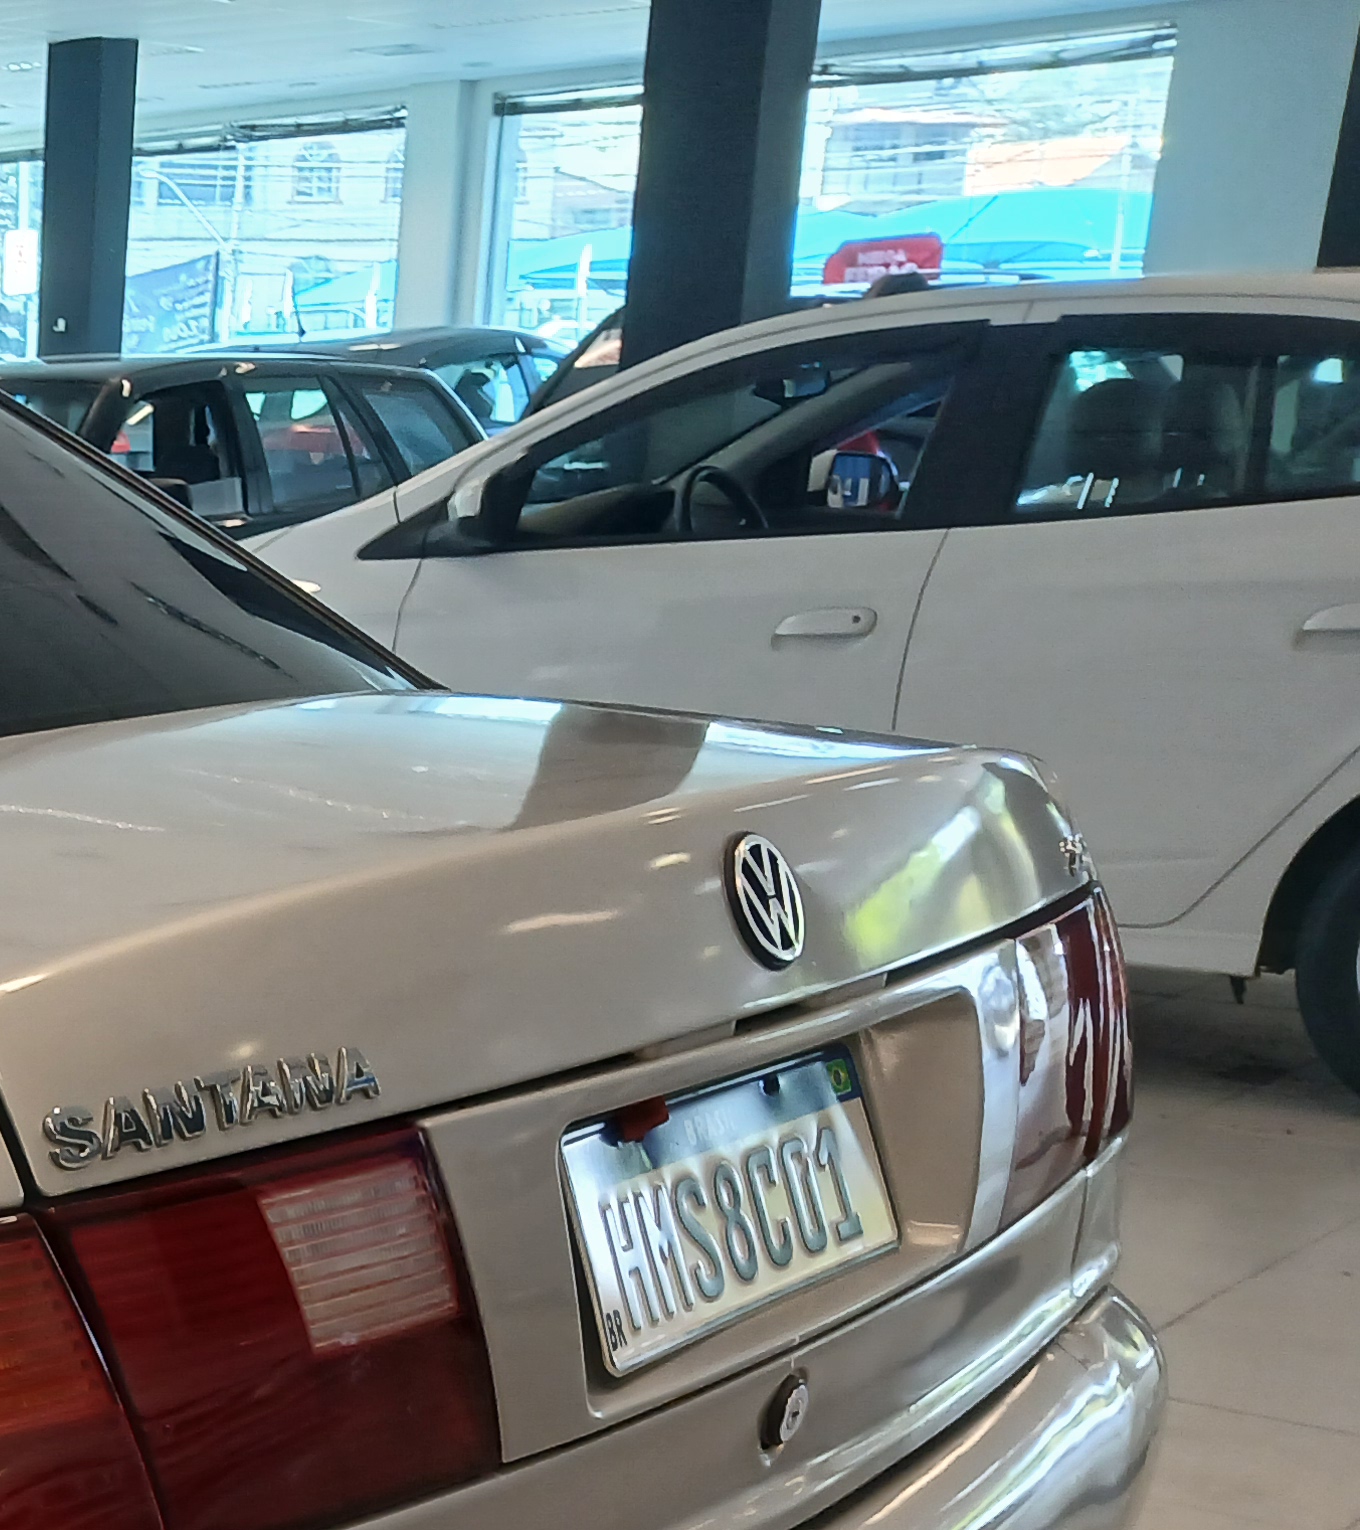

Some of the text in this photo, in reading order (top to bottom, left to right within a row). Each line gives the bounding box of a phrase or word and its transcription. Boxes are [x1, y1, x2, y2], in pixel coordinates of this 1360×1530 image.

[43, 1046, 381, 1170] SANTANA
[598, 1126, 864, 1332] HMS8C01
[606, 1309, 628, 1351] BR
